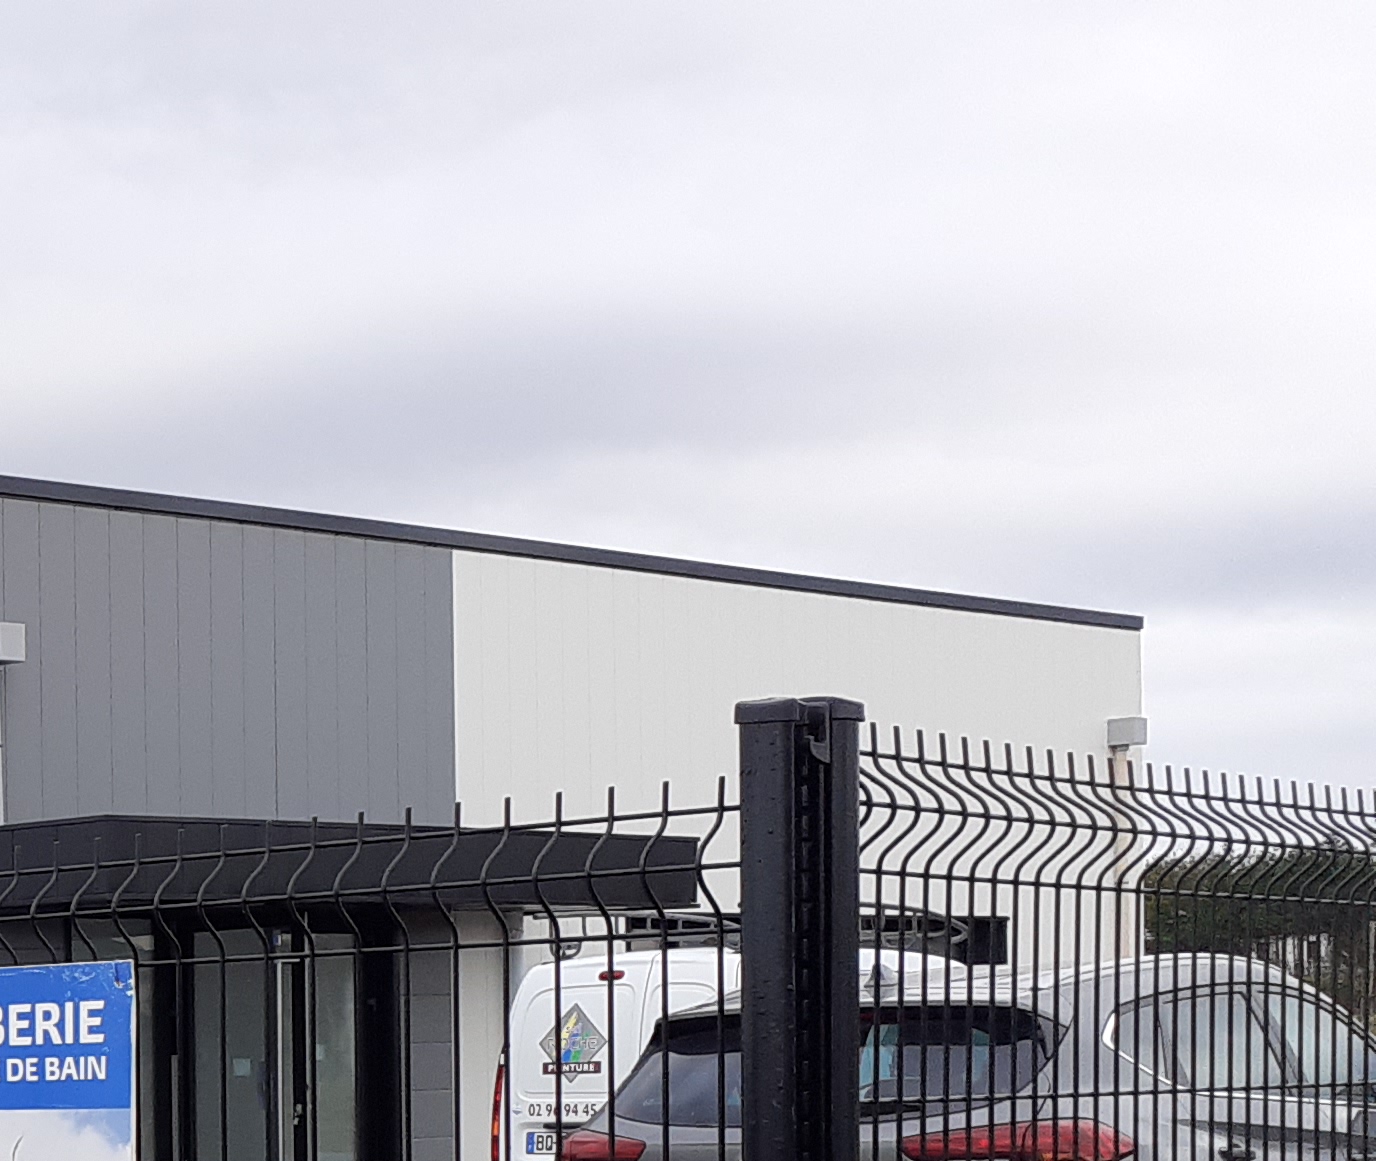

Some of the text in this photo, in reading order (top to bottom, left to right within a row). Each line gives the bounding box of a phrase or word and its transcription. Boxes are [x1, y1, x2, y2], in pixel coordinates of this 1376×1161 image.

[6, 1058, 39, 1082] DE
[45, 1055, 107, 1081] BAIN
[528, 1103, 542, 1117] 02
[564, 1103, 578, 1117] 94
